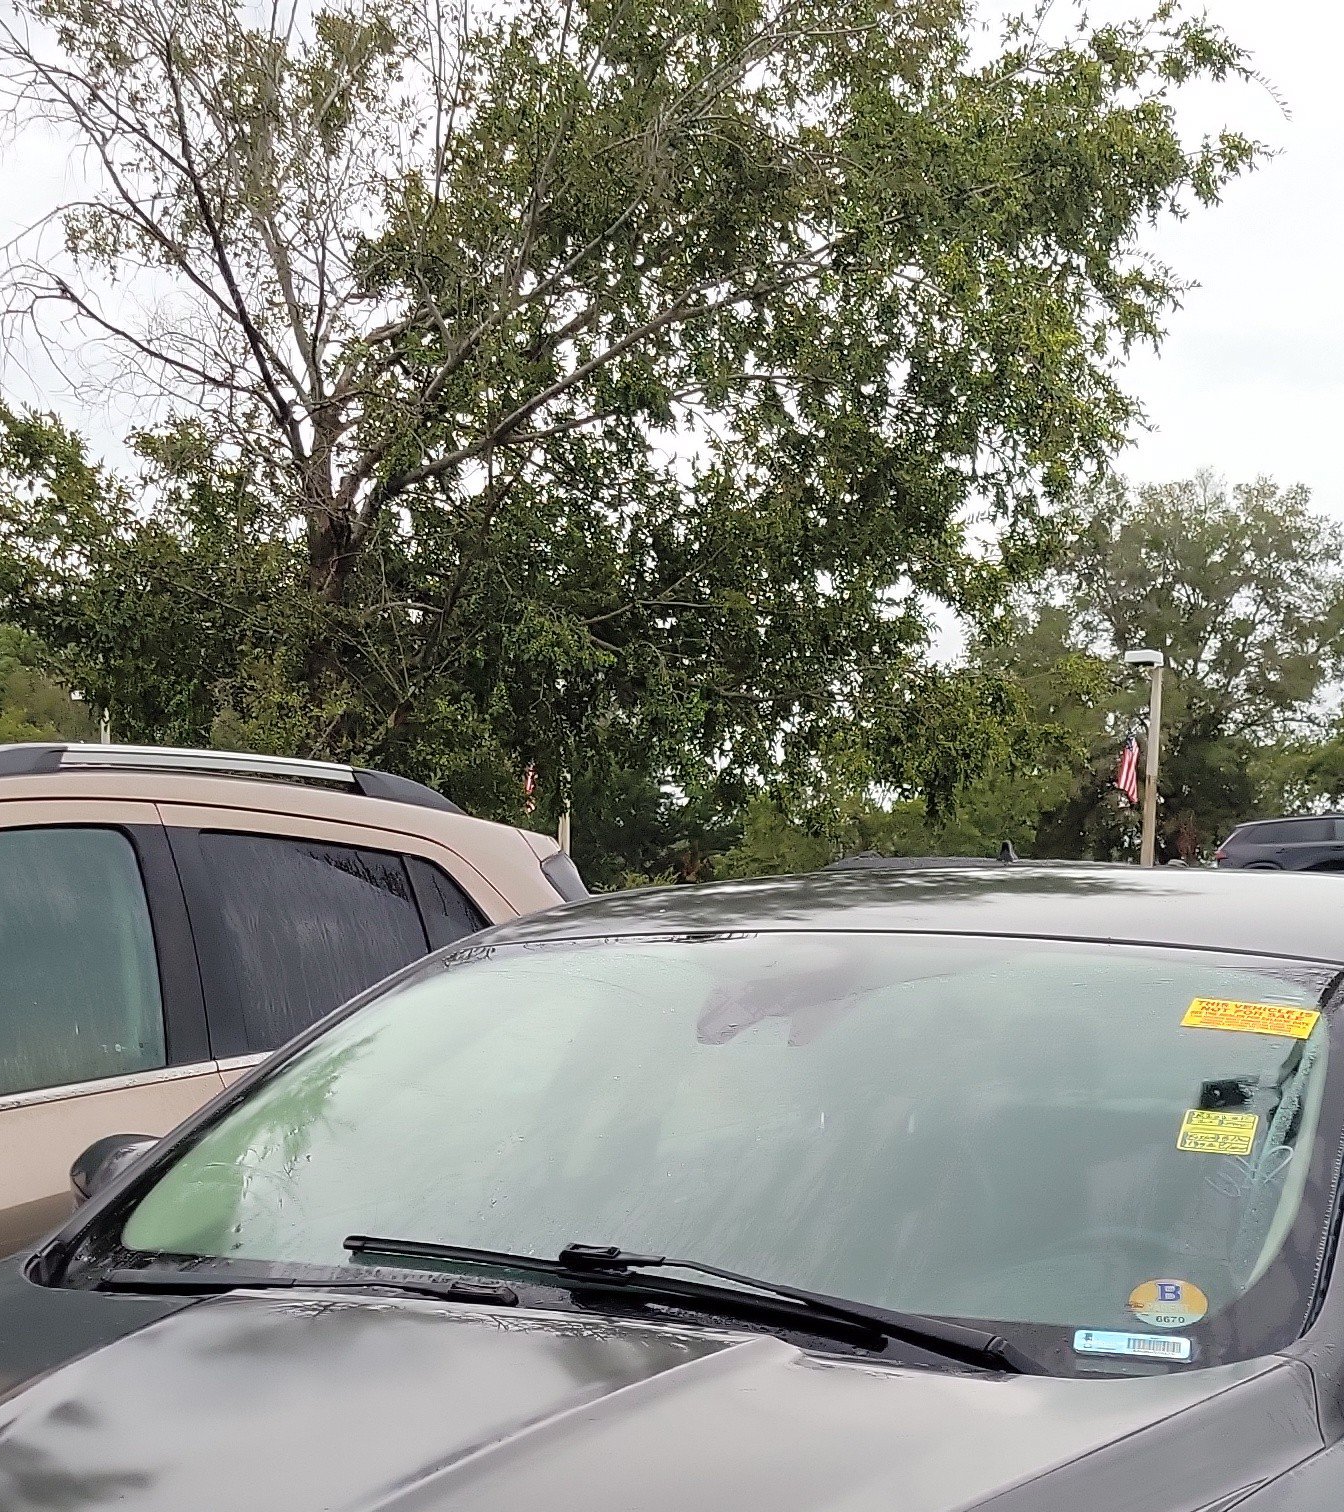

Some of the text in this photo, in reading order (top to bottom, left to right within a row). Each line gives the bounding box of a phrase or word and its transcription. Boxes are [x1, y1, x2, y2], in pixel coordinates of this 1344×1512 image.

[1234, 1003, 1296, 1015] VEHICLE
[1268, 1012, 1305, 1021] SALE
[1157, 1283, 1181, 1302] B
